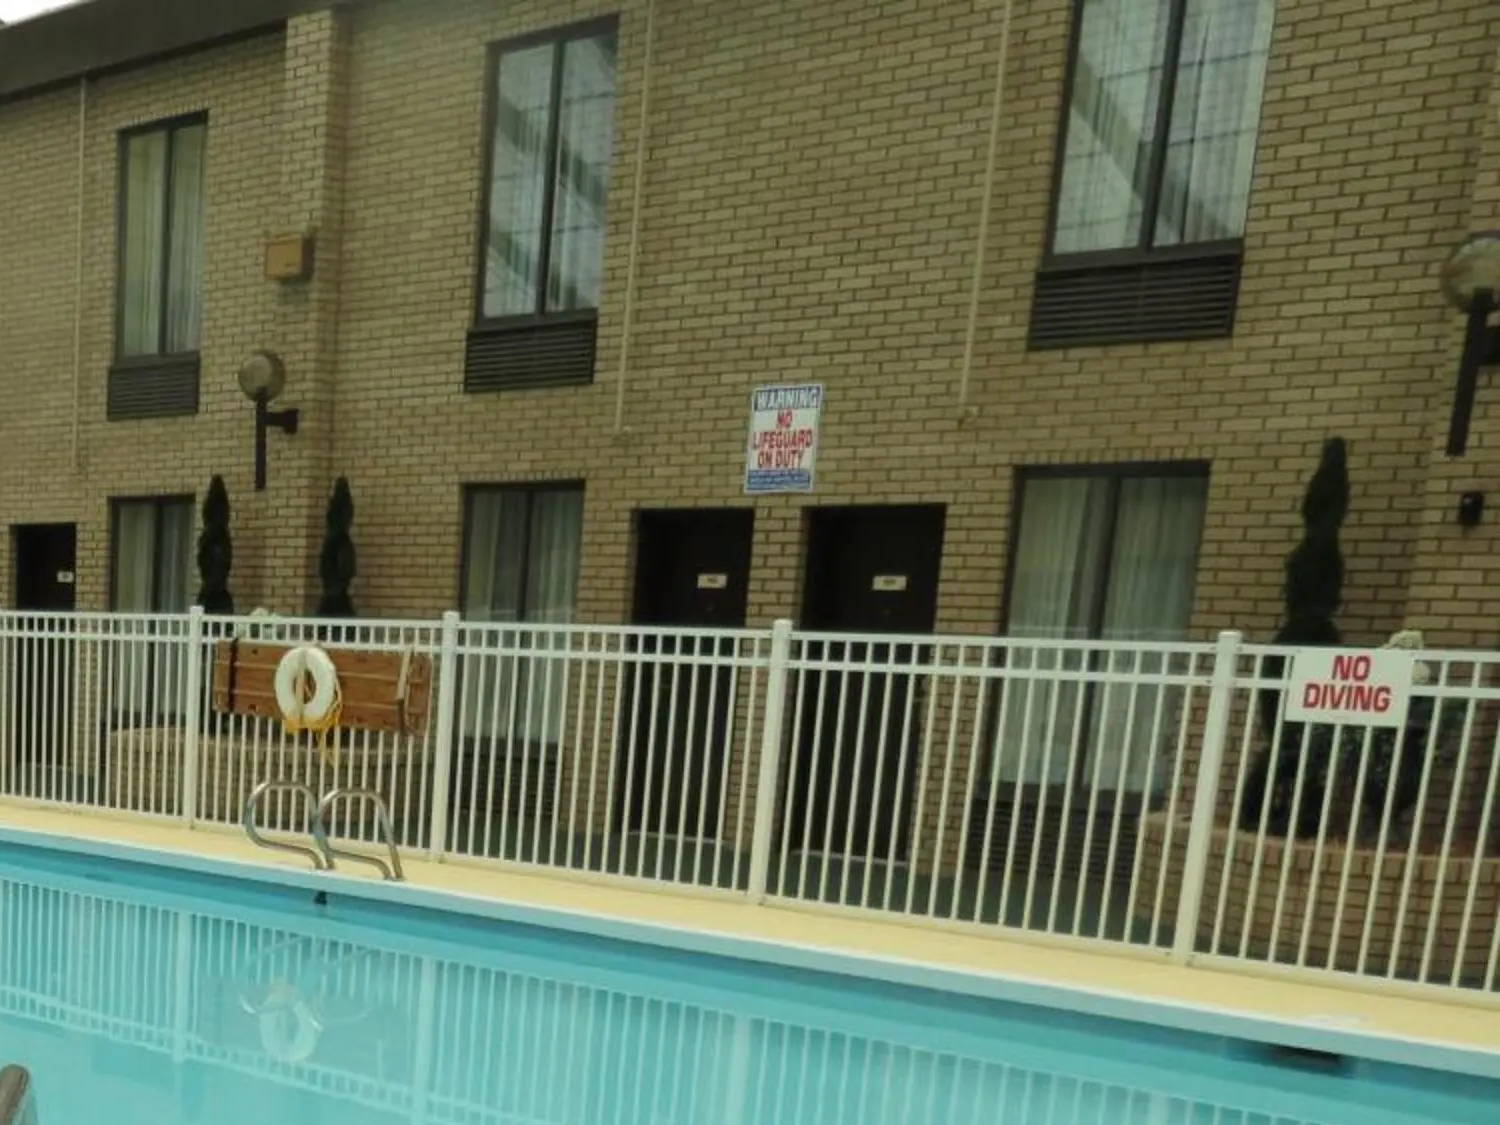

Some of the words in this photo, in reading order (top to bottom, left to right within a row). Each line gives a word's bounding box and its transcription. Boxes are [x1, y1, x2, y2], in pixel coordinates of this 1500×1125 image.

[755, 387, 819, 410] WARNING
[777, 410, 793, 428] NO
[753, 429, 812, 449] LIFEGUARD
[757, 450, 773, 469] ON
[775, 448, 805, 469] DUTY
[1331, 654, 1372, 681] NO
[1302, 683, 1392, 713] DIVING
